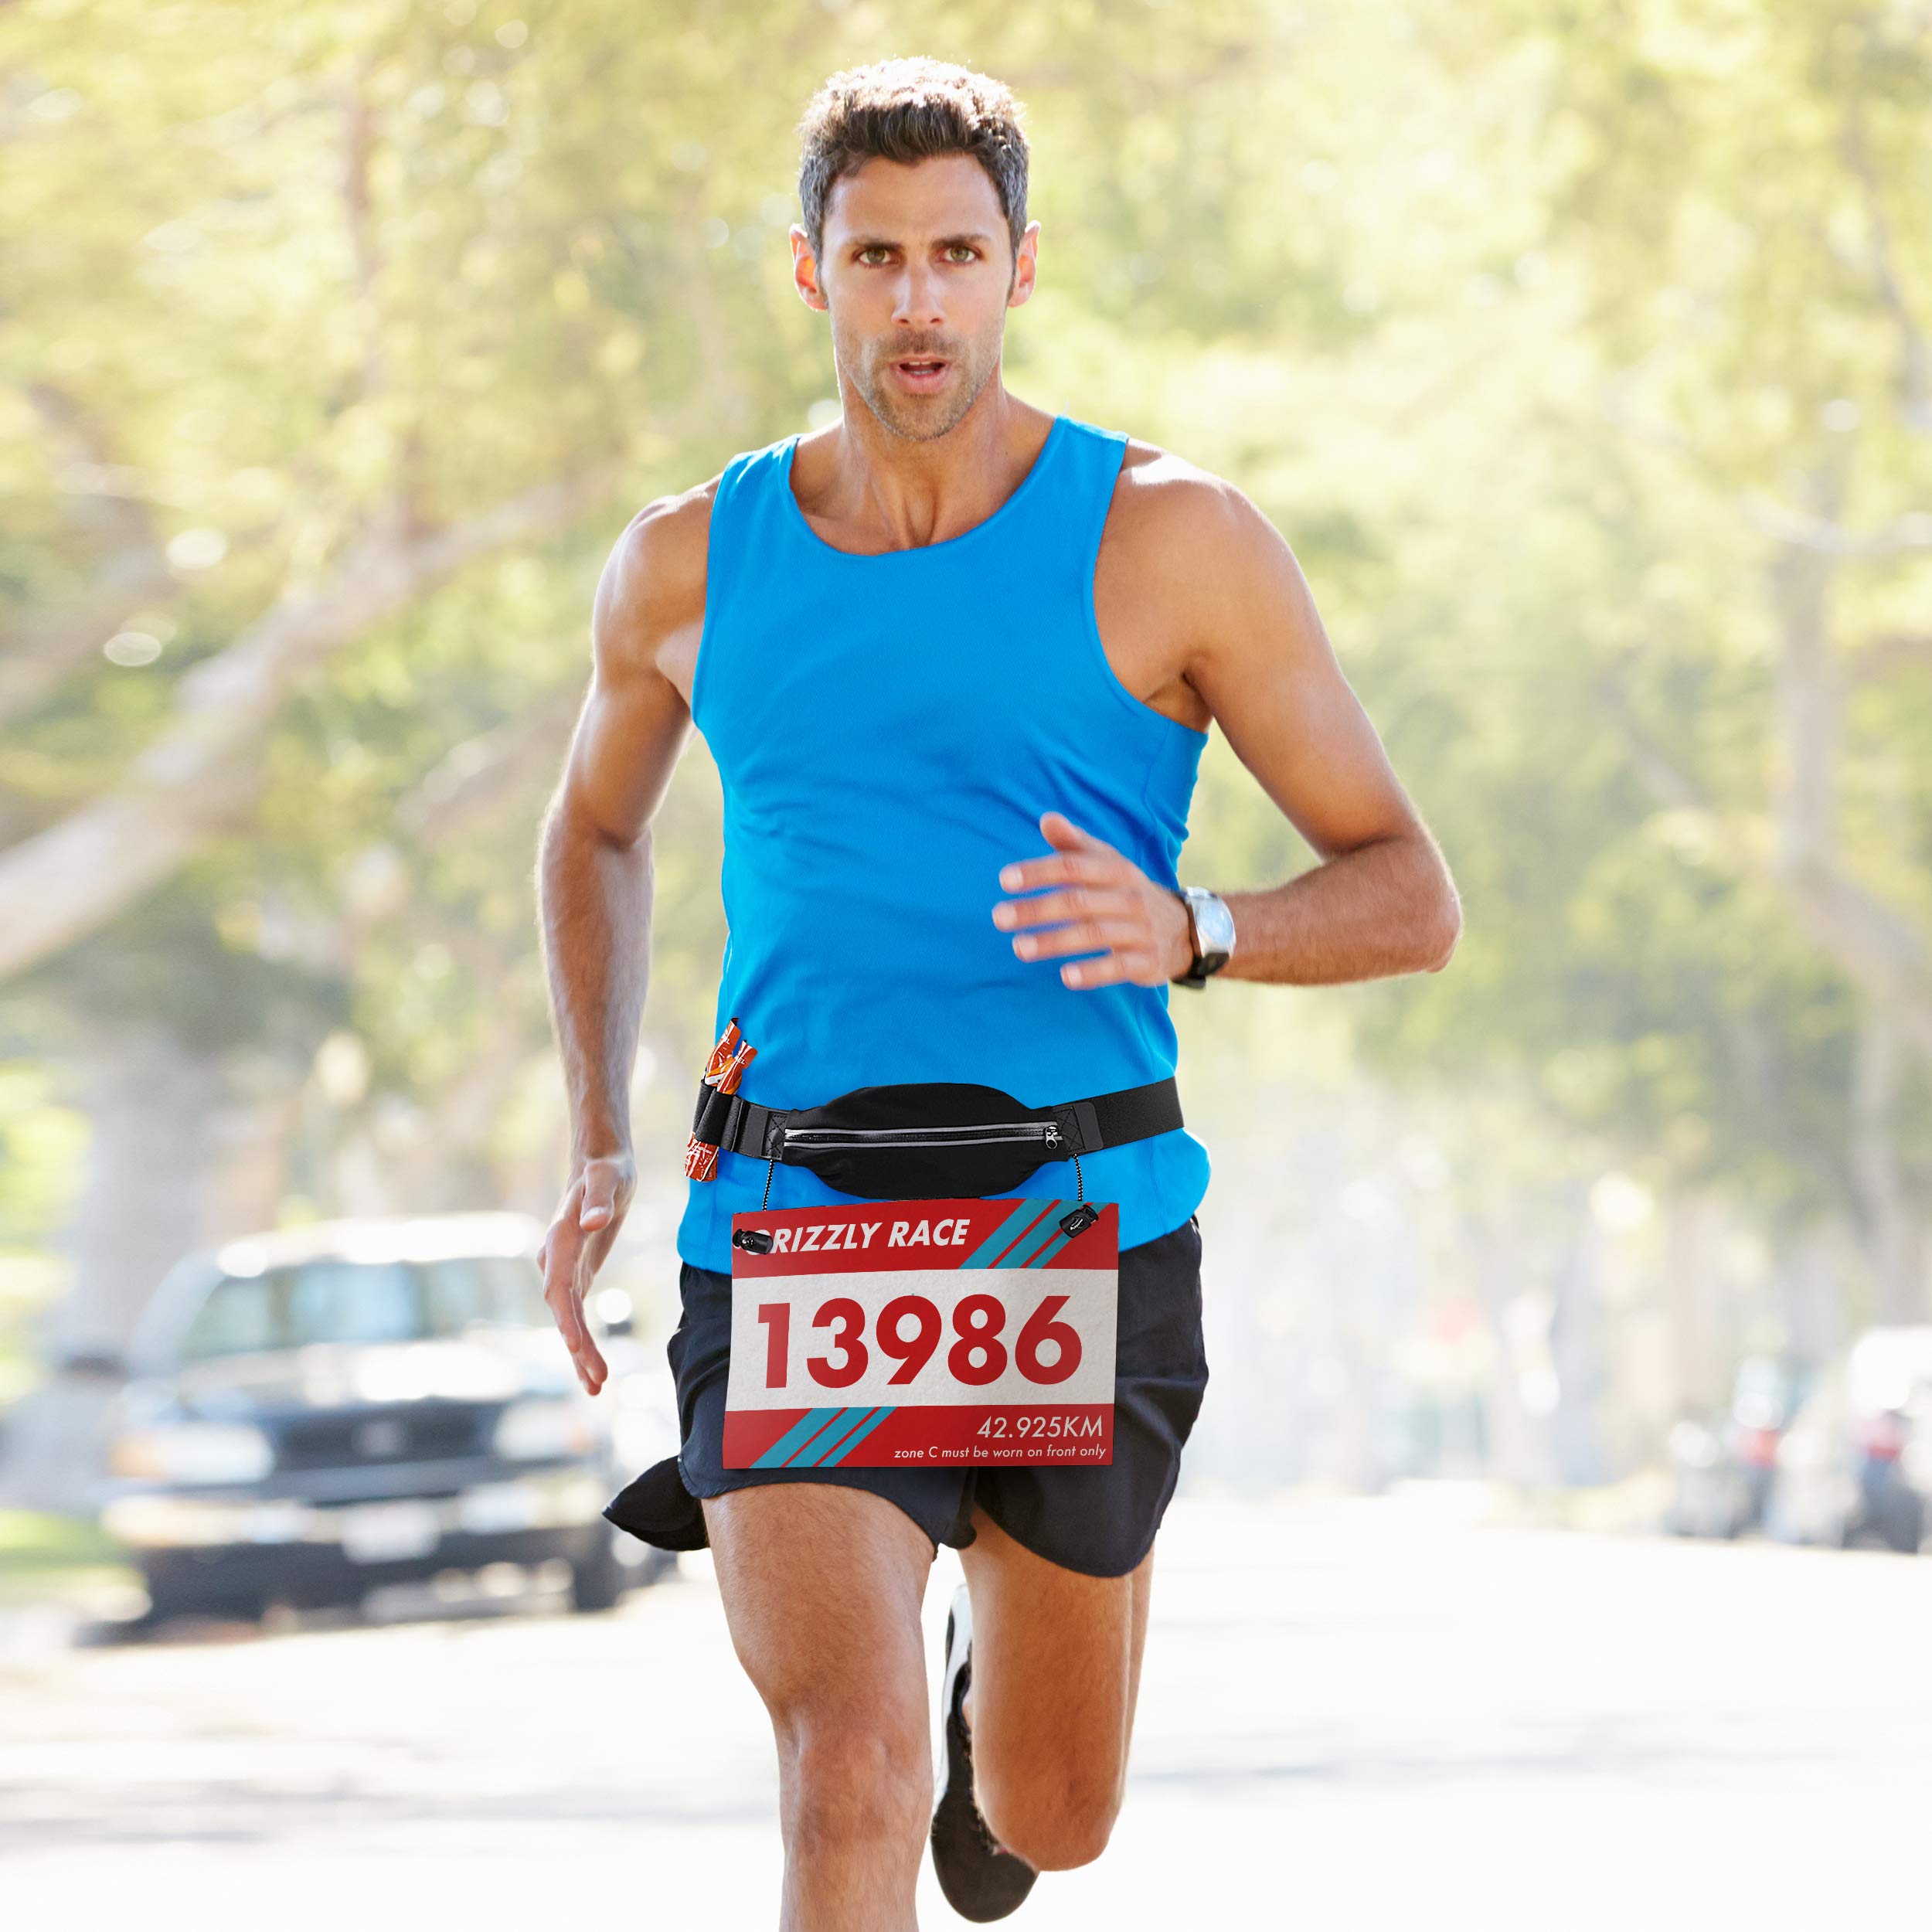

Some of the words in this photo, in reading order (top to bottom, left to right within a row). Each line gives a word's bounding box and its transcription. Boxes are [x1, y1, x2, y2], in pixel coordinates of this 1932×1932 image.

[887, 1219, 971, 1248] RACE
[757, 1294, 1083, 1389] 13986
[976, 1415, 1103, 1438] 42.925KM
[893, 1450, 924, 1458] zone
[928, 1446, 938, 1458] C
[941, 1447, 970, 1458] must
[973, 1444, 989, 1458] be
[992, 1449, 1023, 1458] worn
[1046, 1444, 1077, 1457] front
[1080, 1443, 1107, 1460] only
